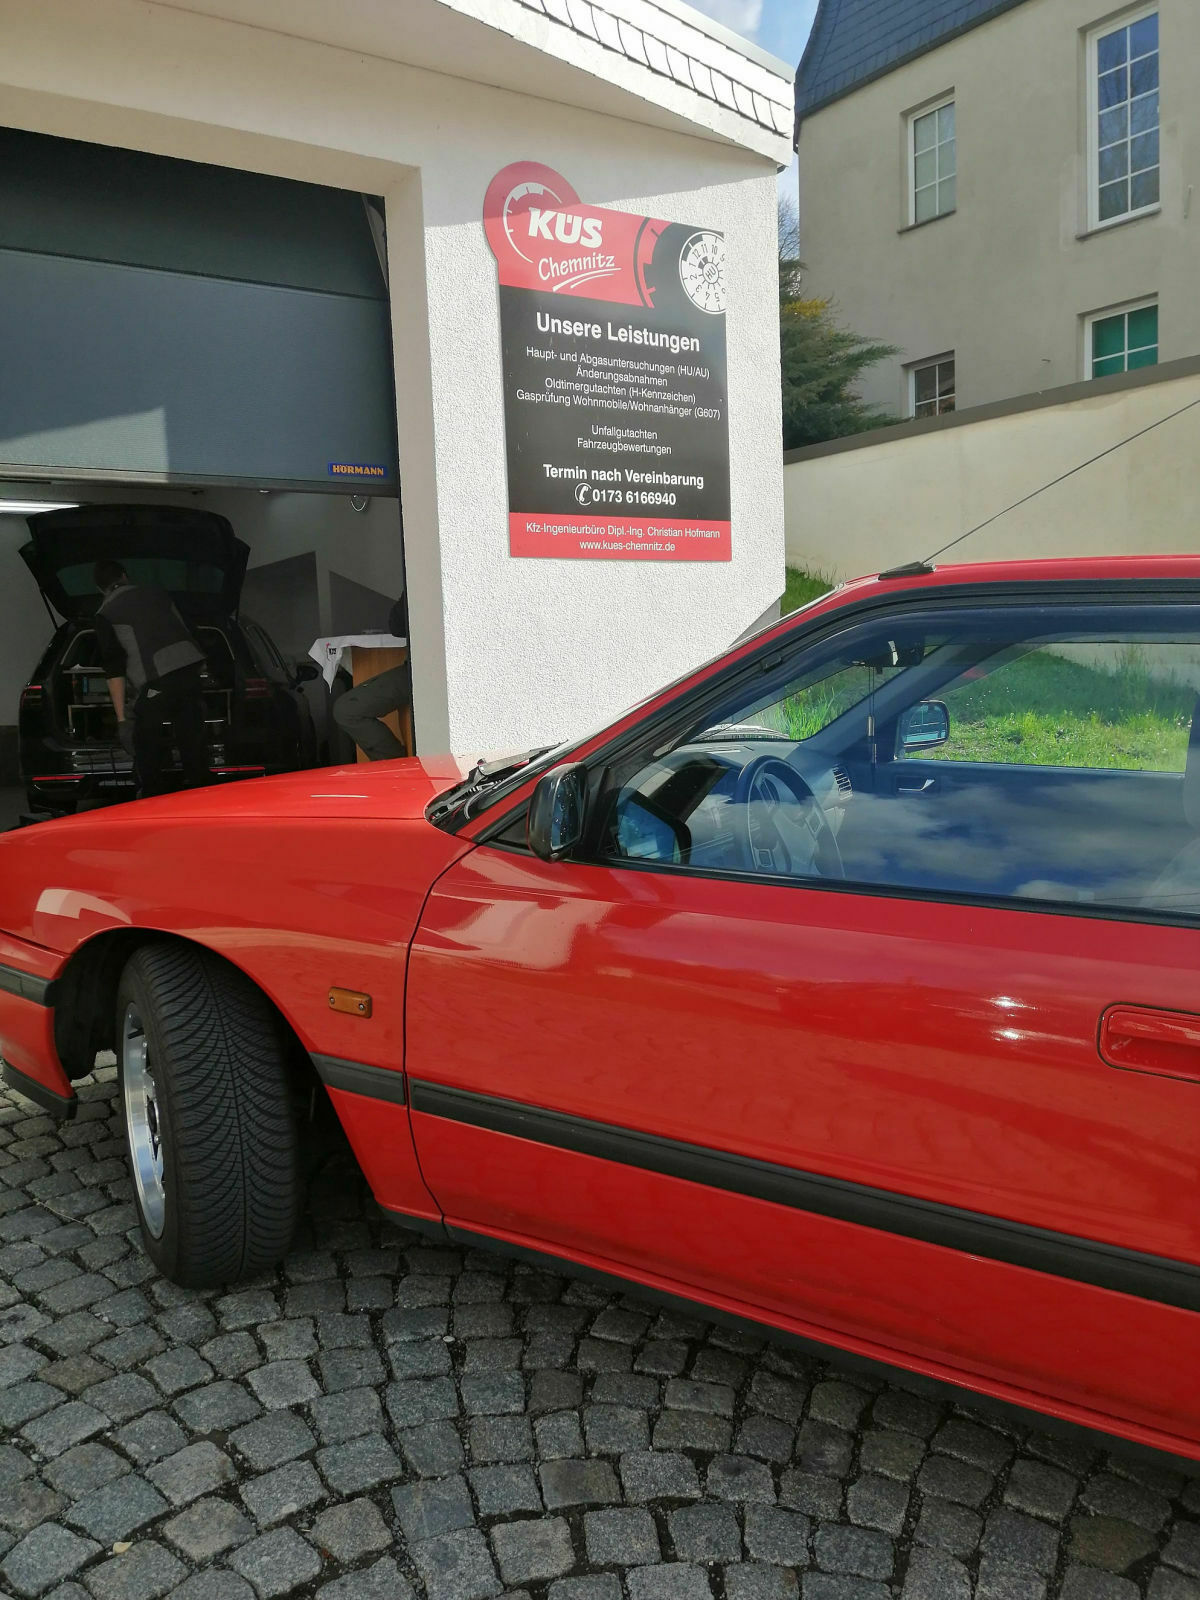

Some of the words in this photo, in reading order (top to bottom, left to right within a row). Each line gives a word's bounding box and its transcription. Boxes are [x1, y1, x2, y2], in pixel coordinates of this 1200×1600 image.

[528, 207, 603, 249] KÜS
[538, 253, 615, 281] Chemnitz
[705, 265, 716, 281] HU
[536, 311, 602, 338] Unsere
[607, 321, 700, 354] Leistungen
[526, 346, 557, 360] Haupt-
[560, 351, 577, 363] und
[580, 352, 675, 375] Abgasuntersuchungen
[677, 365, 710, 380] (HU/AU)
[576, 364, 668, 387] Änderungsabnahmen
[545, 377, 626, 396] Oldtimergutachten
[629, 387, 696, 404] (H-Kennzeichen)
[516, 389, 571, 407] Gasprüfung
[572, 394, 692, 418] Wohnmobile/Wohnanhänger
[694, 407, 721, 421] (G607)
[591, 424, 658, 440] Unfallgutachten
[577, 438, 672, 456] Fahrzeugbewertungen
[543, 463, 588, 480] Termin
[591, 468, 621, 482] nach
[625, 468, 704, 490] Vereinbarung
[592, 489, 623, 503] 0173
[626, 491, 677, 506] 6166940
[526, 522, 605, 535] Kfz-Ingenieurbüro
[607, 524, 645, 537] Dipl.-Ing.
[647, 526, 683, 537] Christian
[685, 527, 720, 539] Hofmann
[579, 540, 676, 552] www.kues-chemnitz.de
